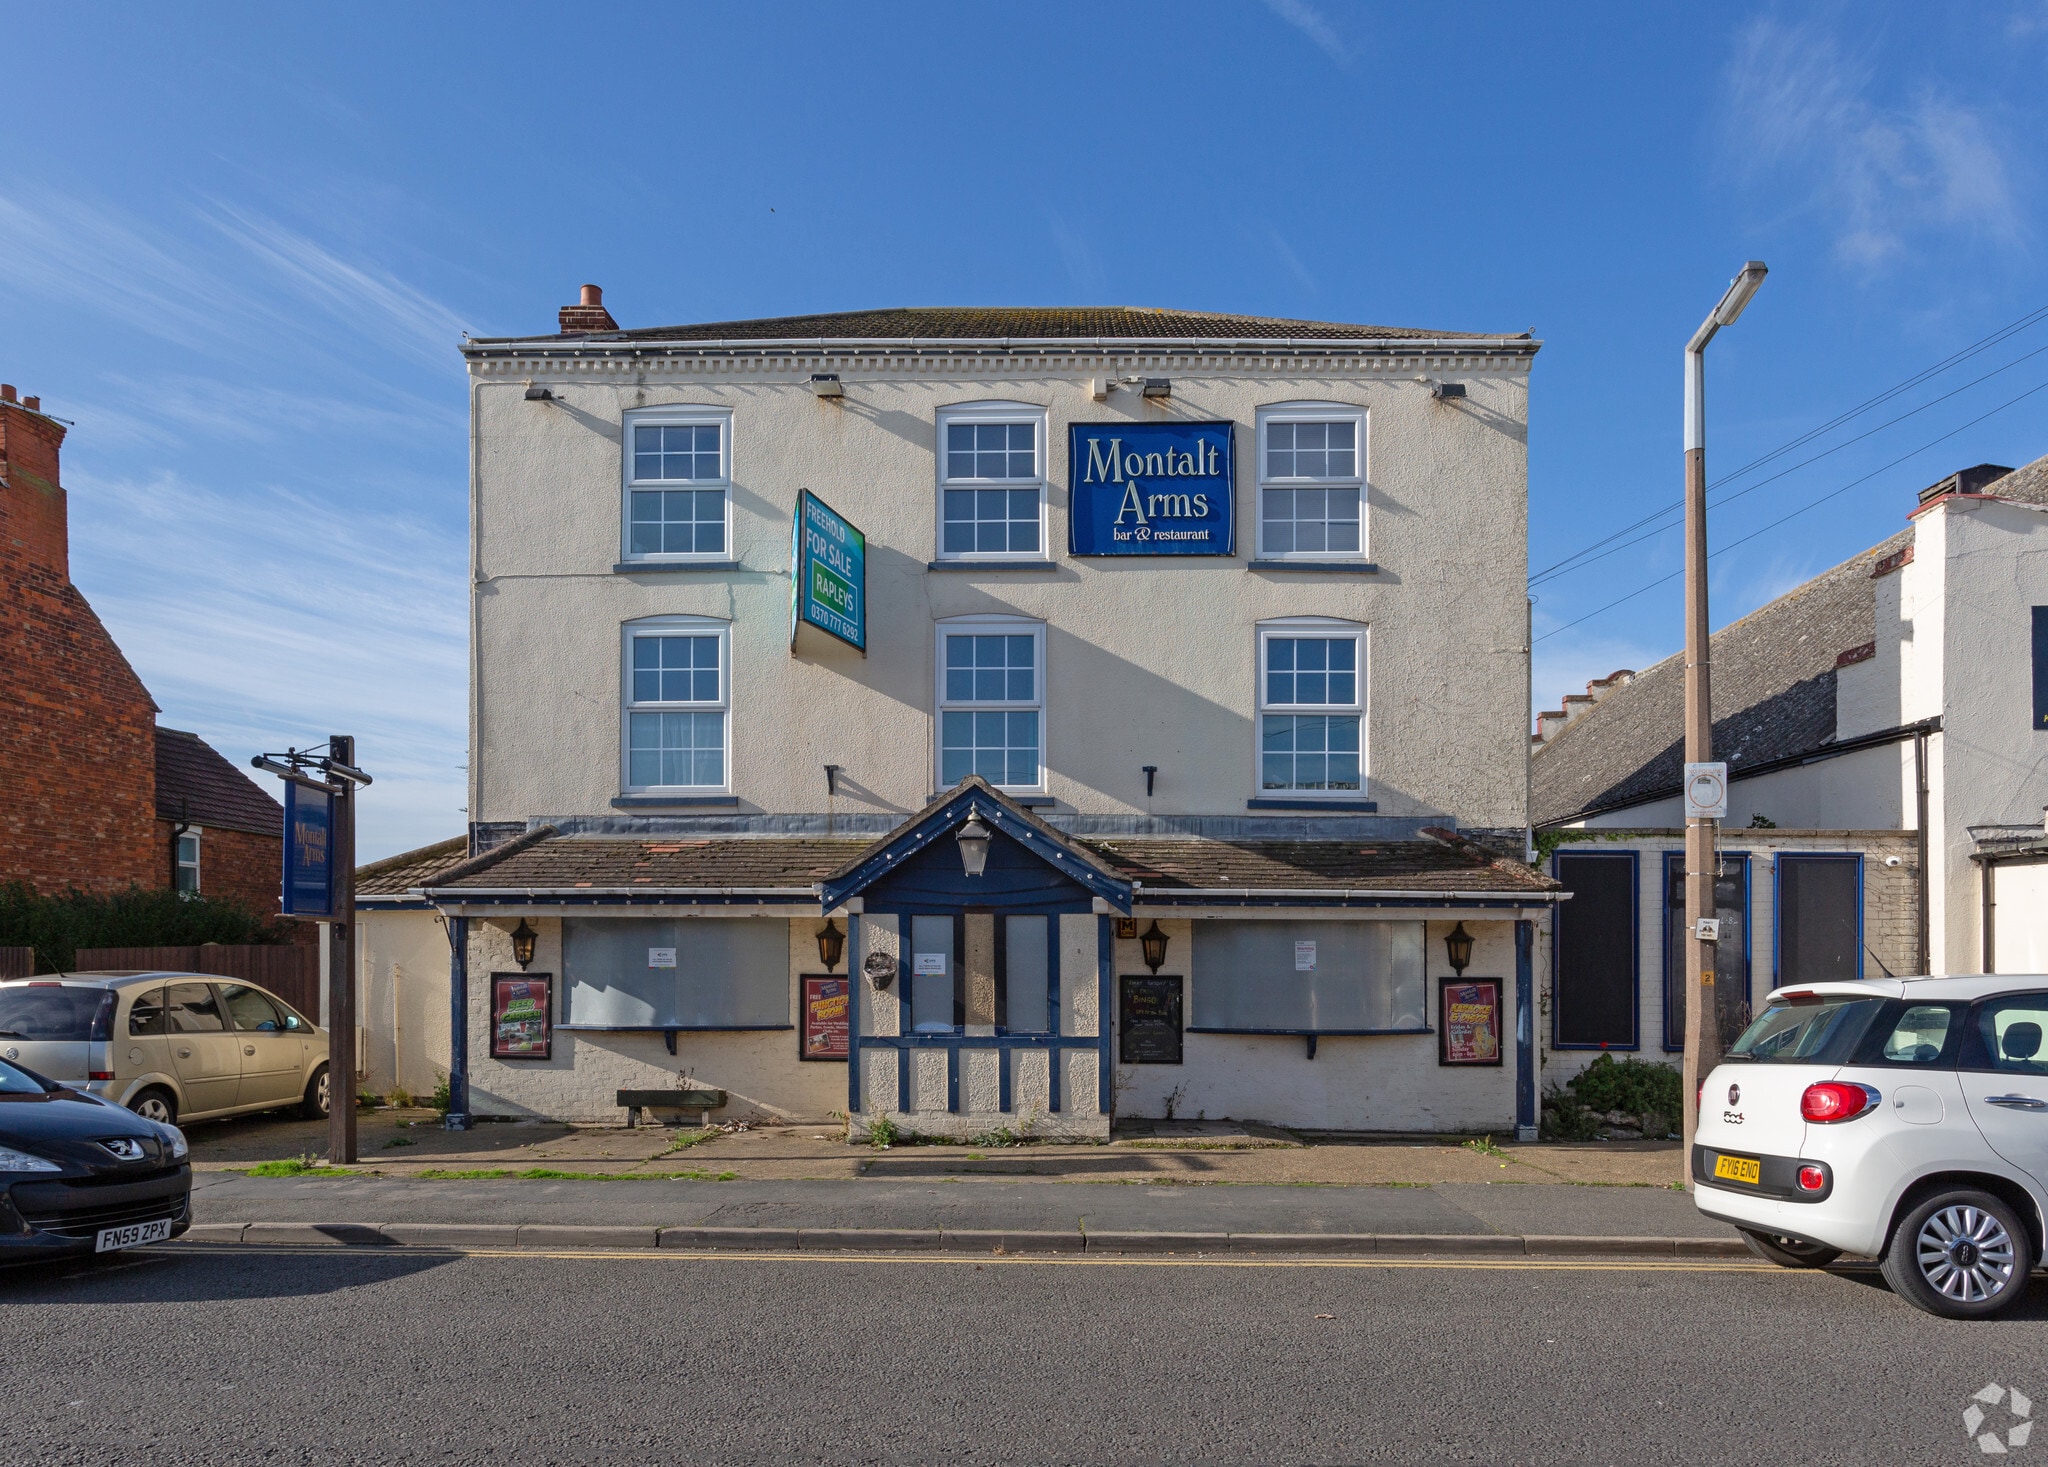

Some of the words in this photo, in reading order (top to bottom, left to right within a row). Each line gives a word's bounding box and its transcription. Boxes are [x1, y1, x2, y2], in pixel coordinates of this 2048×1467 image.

[1083, 438, 1220, 483] Montalt
[1114, 480, 1209, 525] Arms
[807, 501, 845, 543] FREEHOLD
[1114, 528, 1132, 541] bar
[1134, 527, 1151, 541] &
[1154, 528, 1210, 541] restaurant
[807, 528, 827, 560] FOR
[829, 546, 852, 578] SALE
[816, 573, 853, 612] RAPLEYS
[811, 604, 829, 625] 0370
[830, 614, 842, 632] 777
[842, 624, 859, 641] 6292
[295, 821, 327, 847] Montalt
[303, 844, 325, 867] Arms
[1704, 974, 1711, 982] 2
[509, 999, 535, 1012] BEER
[817, 1006, 845, 1020] ROOM
[1451, 1004, 1491, 1015] KARAOKE
[1461, 1013, 1488, 1023] DISCO
[1720, 1158, 1740, 1175] FY16
[1740, 1161, 1758, 1179] ENO
[103, 1227, 139, 1248] FN59
[142, 1221, 167, 1241] ZPX
